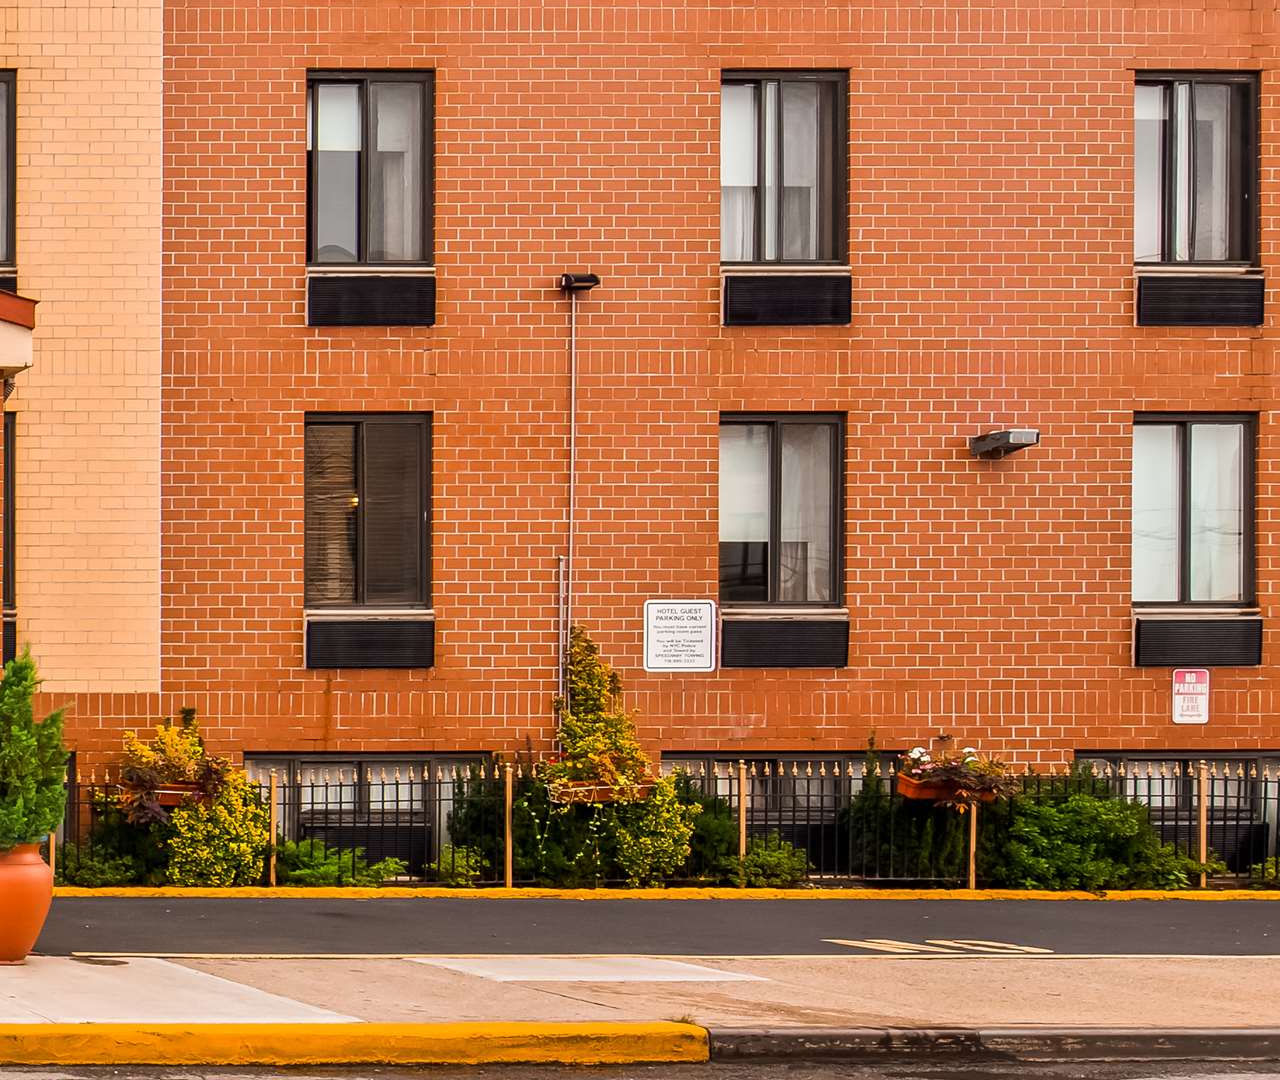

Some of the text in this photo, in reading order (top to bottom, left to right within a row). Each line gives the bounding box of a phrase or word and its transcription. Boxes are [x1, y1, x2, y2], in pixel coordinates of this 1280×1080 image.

[1185, 672, 1196, 683] NO
[1174, 683, 1207, 693] PARKING
[1183, 696, 1199, 704] FIRE
